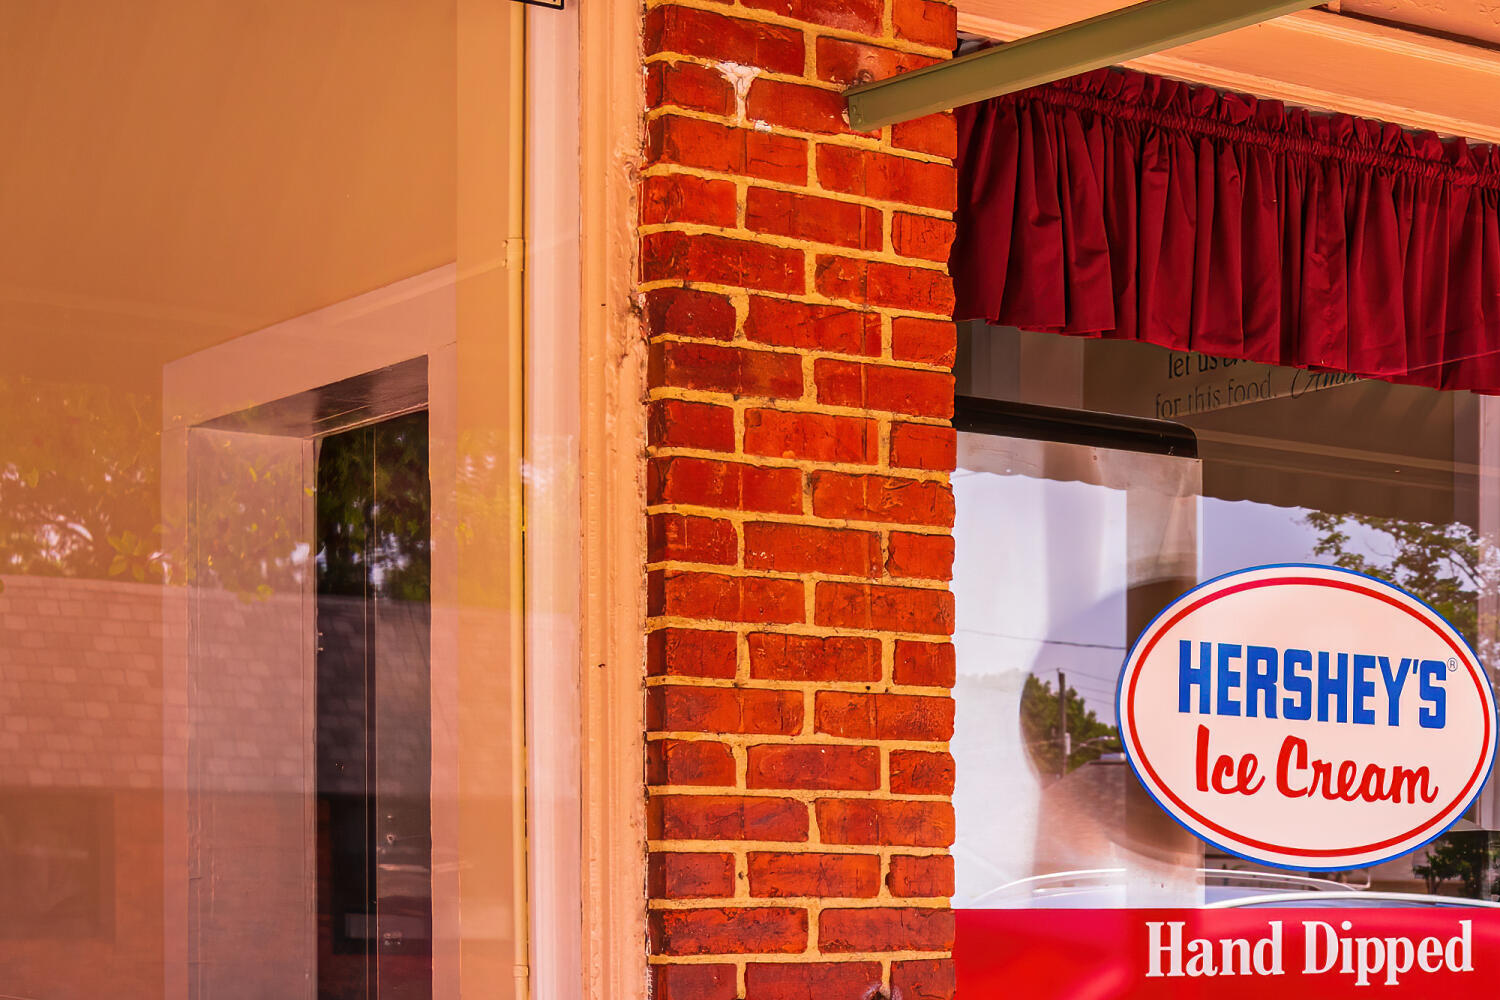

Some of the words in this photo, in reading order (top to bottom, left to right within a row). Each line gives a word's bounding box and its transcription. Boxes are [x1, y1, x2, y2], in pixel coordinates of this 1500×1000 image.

[1155, 392, 1182, 419] for
[1187, 386, 1221, 413] this
[1195, 724, 1266, 796] Ice
[1276, 735, 1439, 804] Cream
[1145, 920, 1285, 977] Hand
[1301, 919, 1474, 986] Dipped
